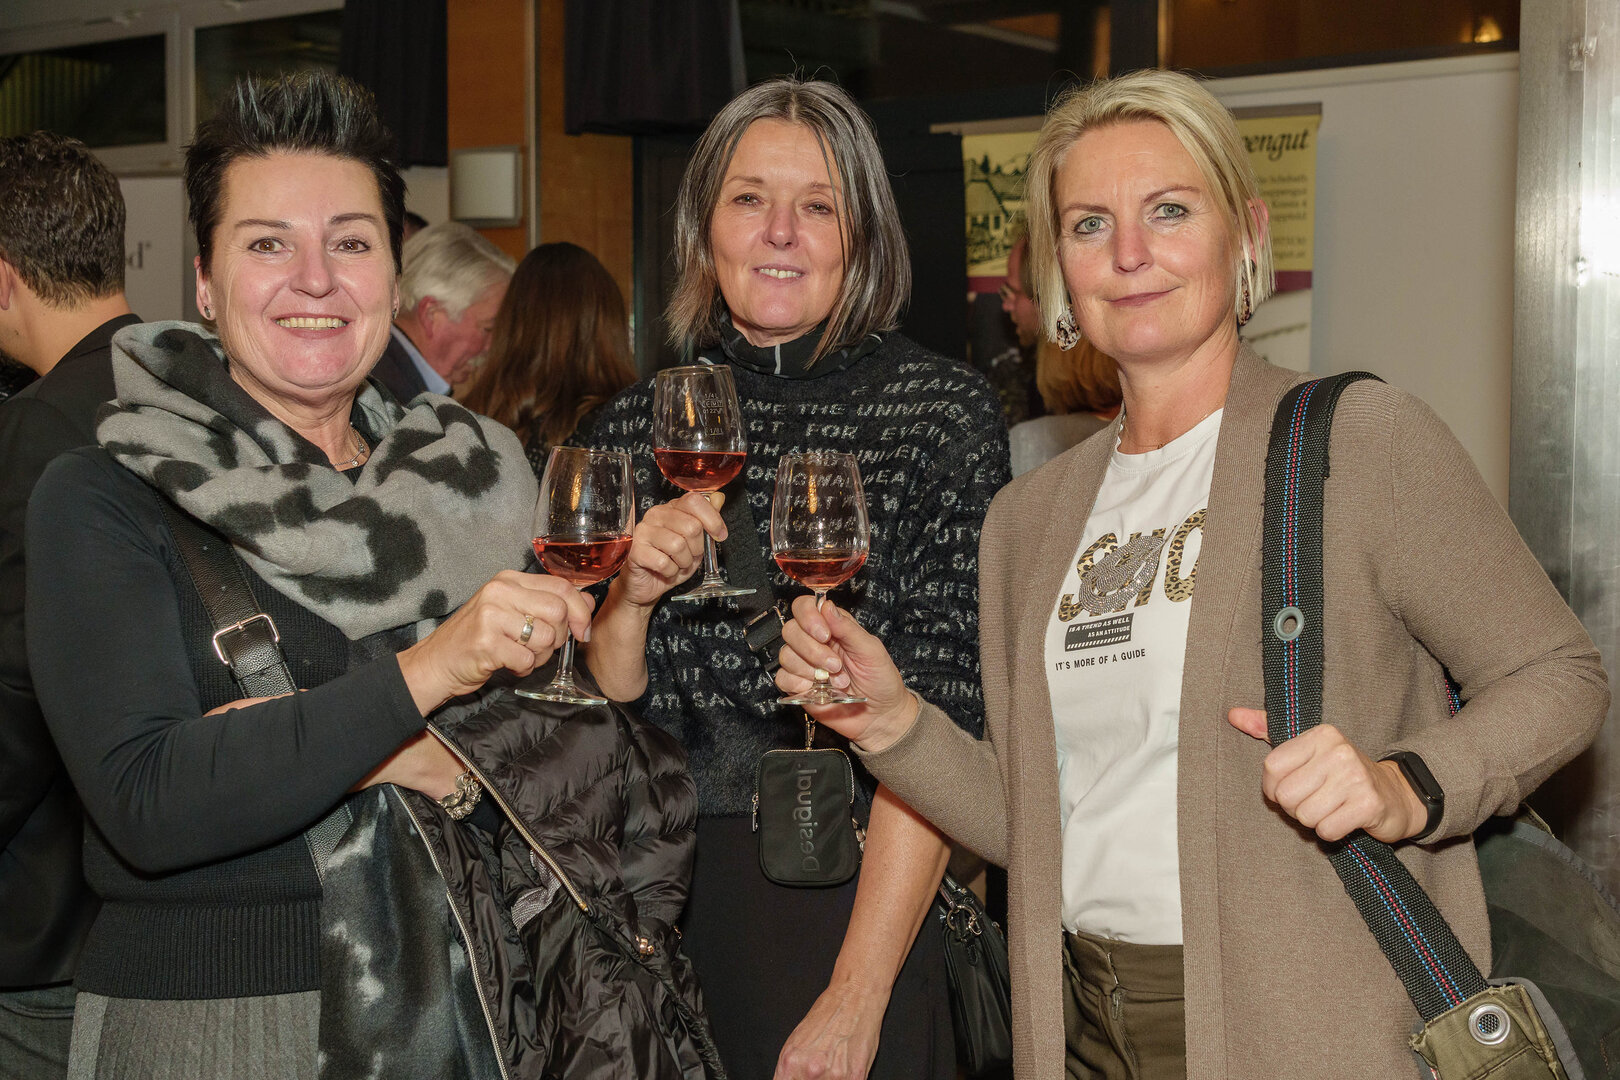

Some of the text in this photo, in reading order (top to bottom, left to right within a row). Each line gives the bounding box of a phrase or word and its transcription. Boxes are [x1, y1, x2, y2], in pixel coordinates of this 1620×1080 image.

[1082, 621, 1103, 631] TREND
[1102, 619, 1112, 627] AS
[1112, 616, 1130, 625] WELL
[1088, 625, 1132, 638] AS AN ATTITUDE
[1074, 656, 1096, 669] MORE
[1098, 655, 1109, 665] OF
[1112, 653, 1119, 663] A
[1121, 647, 1147, 661] GUIDE
